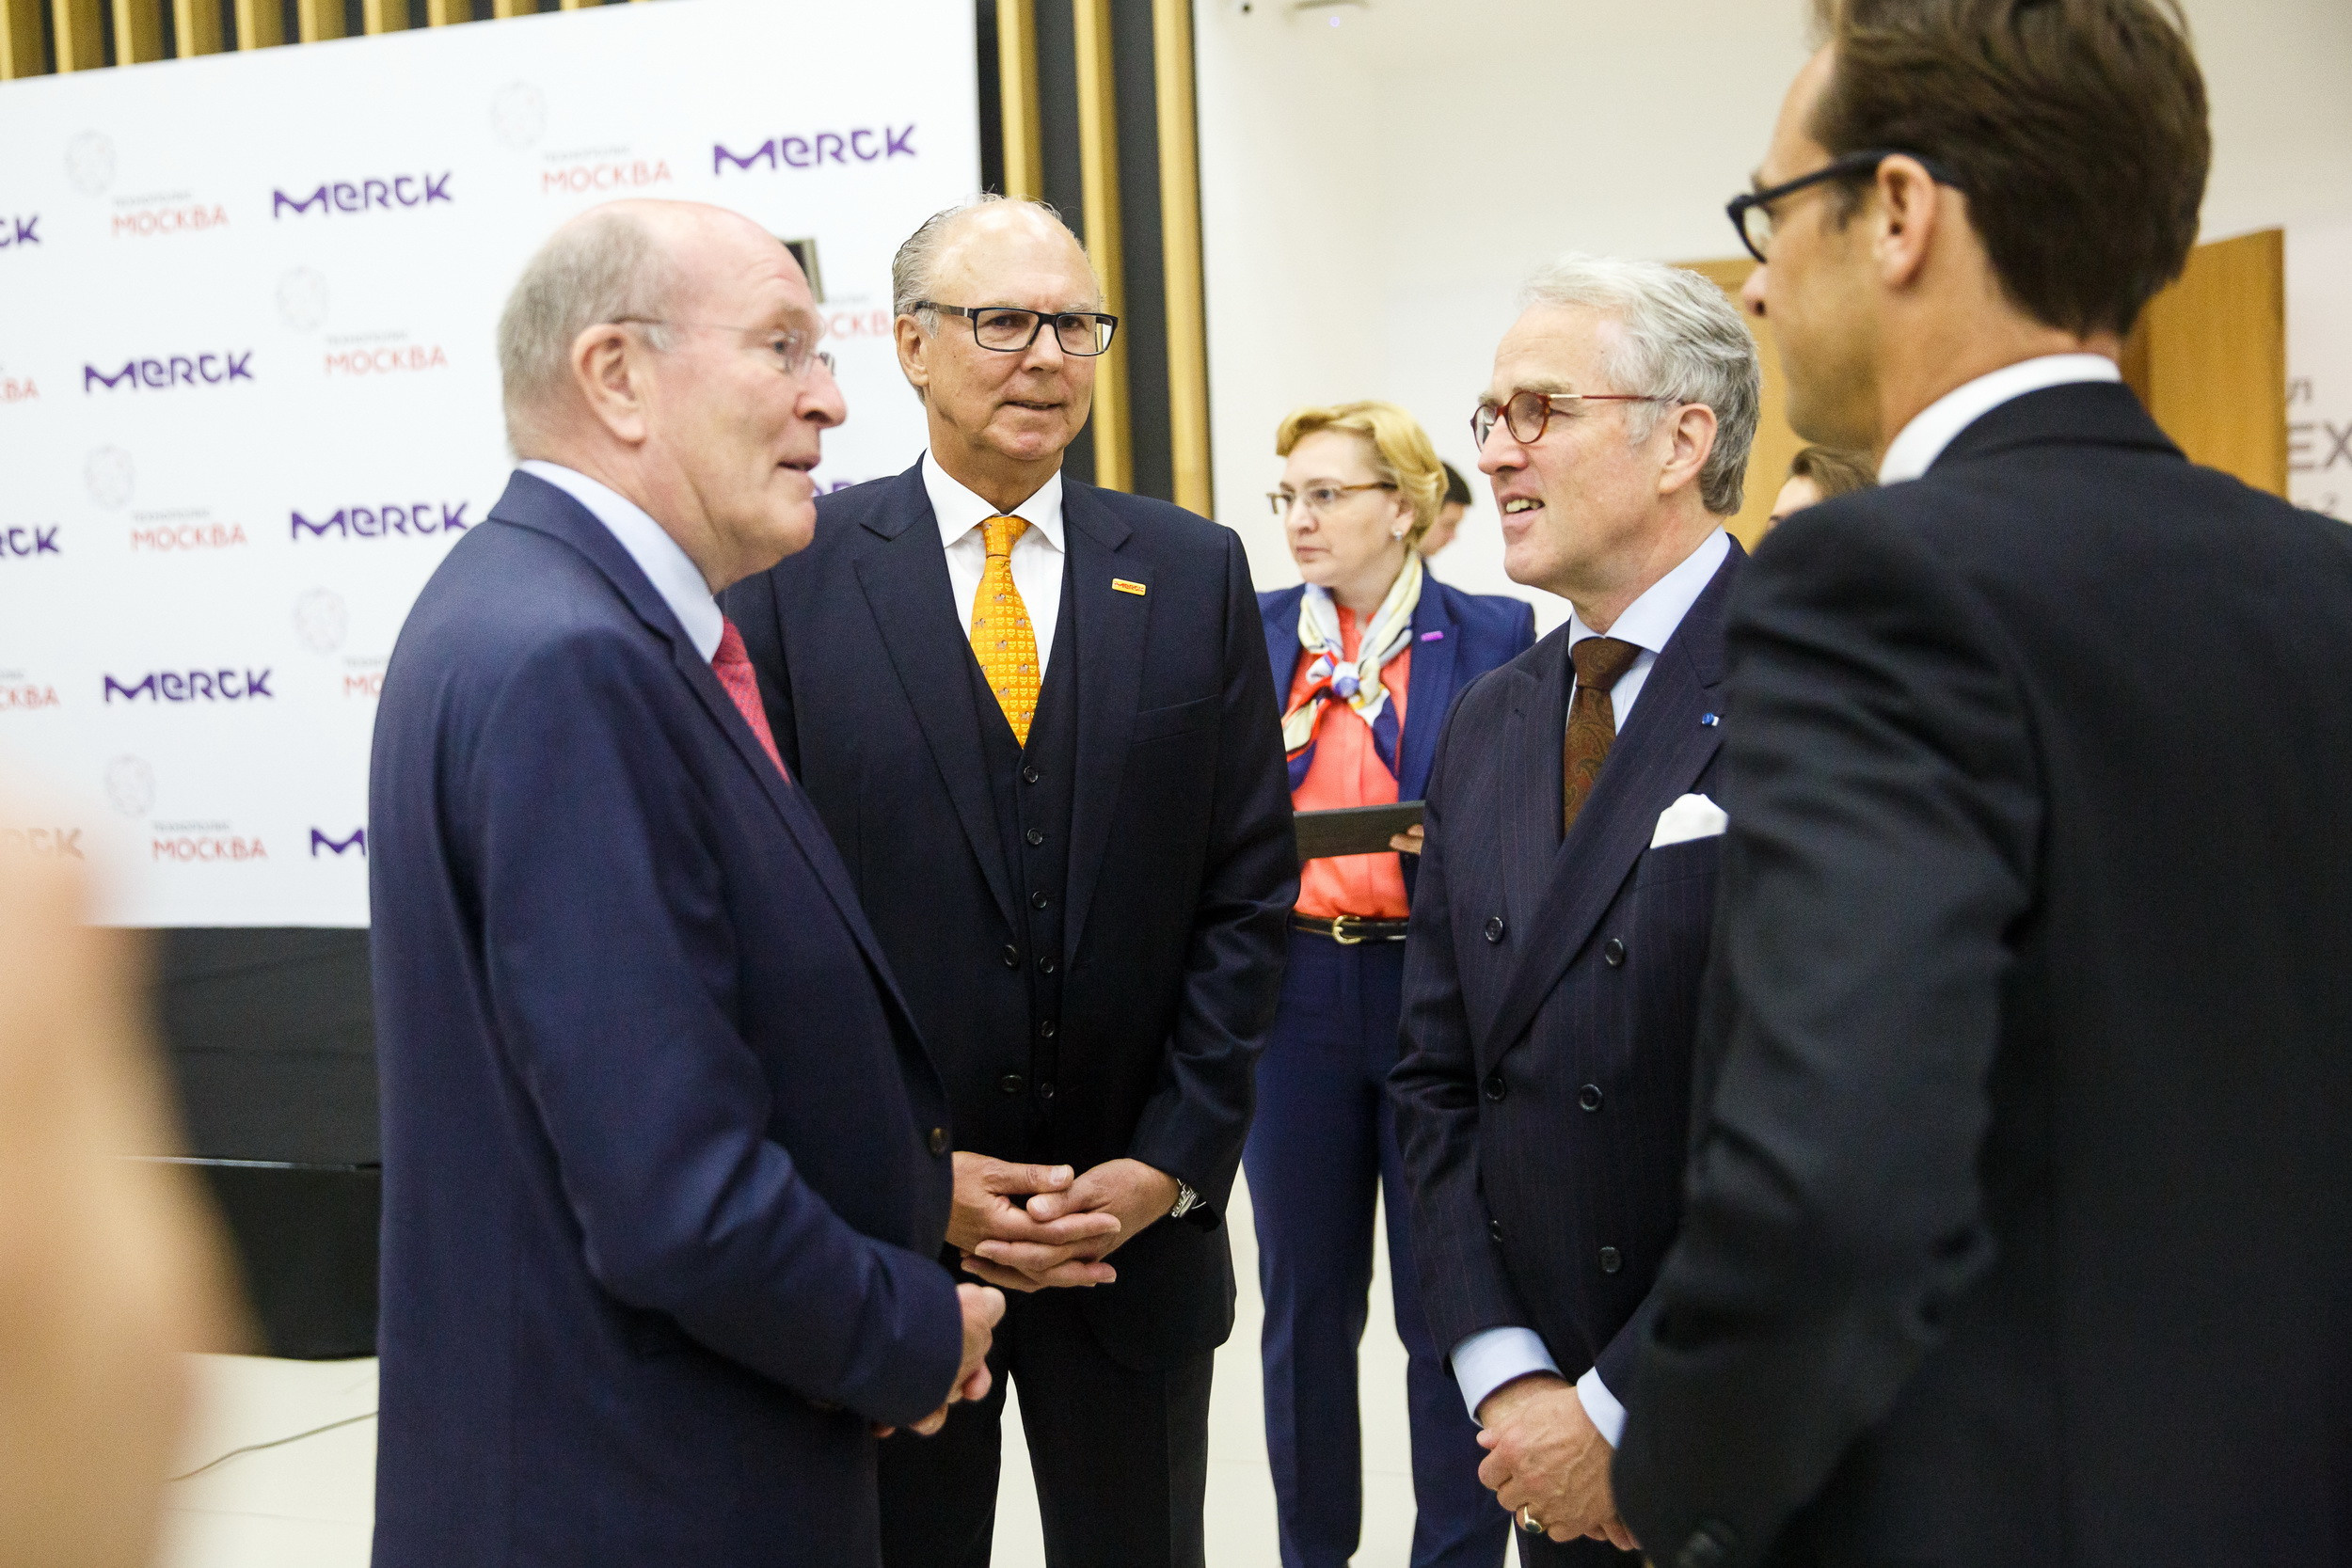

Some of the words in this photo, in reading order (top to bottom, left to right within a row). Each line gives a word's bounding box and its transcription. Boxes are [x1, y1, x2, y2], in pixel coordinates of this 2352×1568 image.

[542, 160, 672, 194] МОСКВА
[112, 204, 229, 237] МОСКВА
[324, 345, 448, 376] МОСКВА
[130, 522, 247, 552] МОСКВА
[151, 835, 268, 863] МОСКВА
